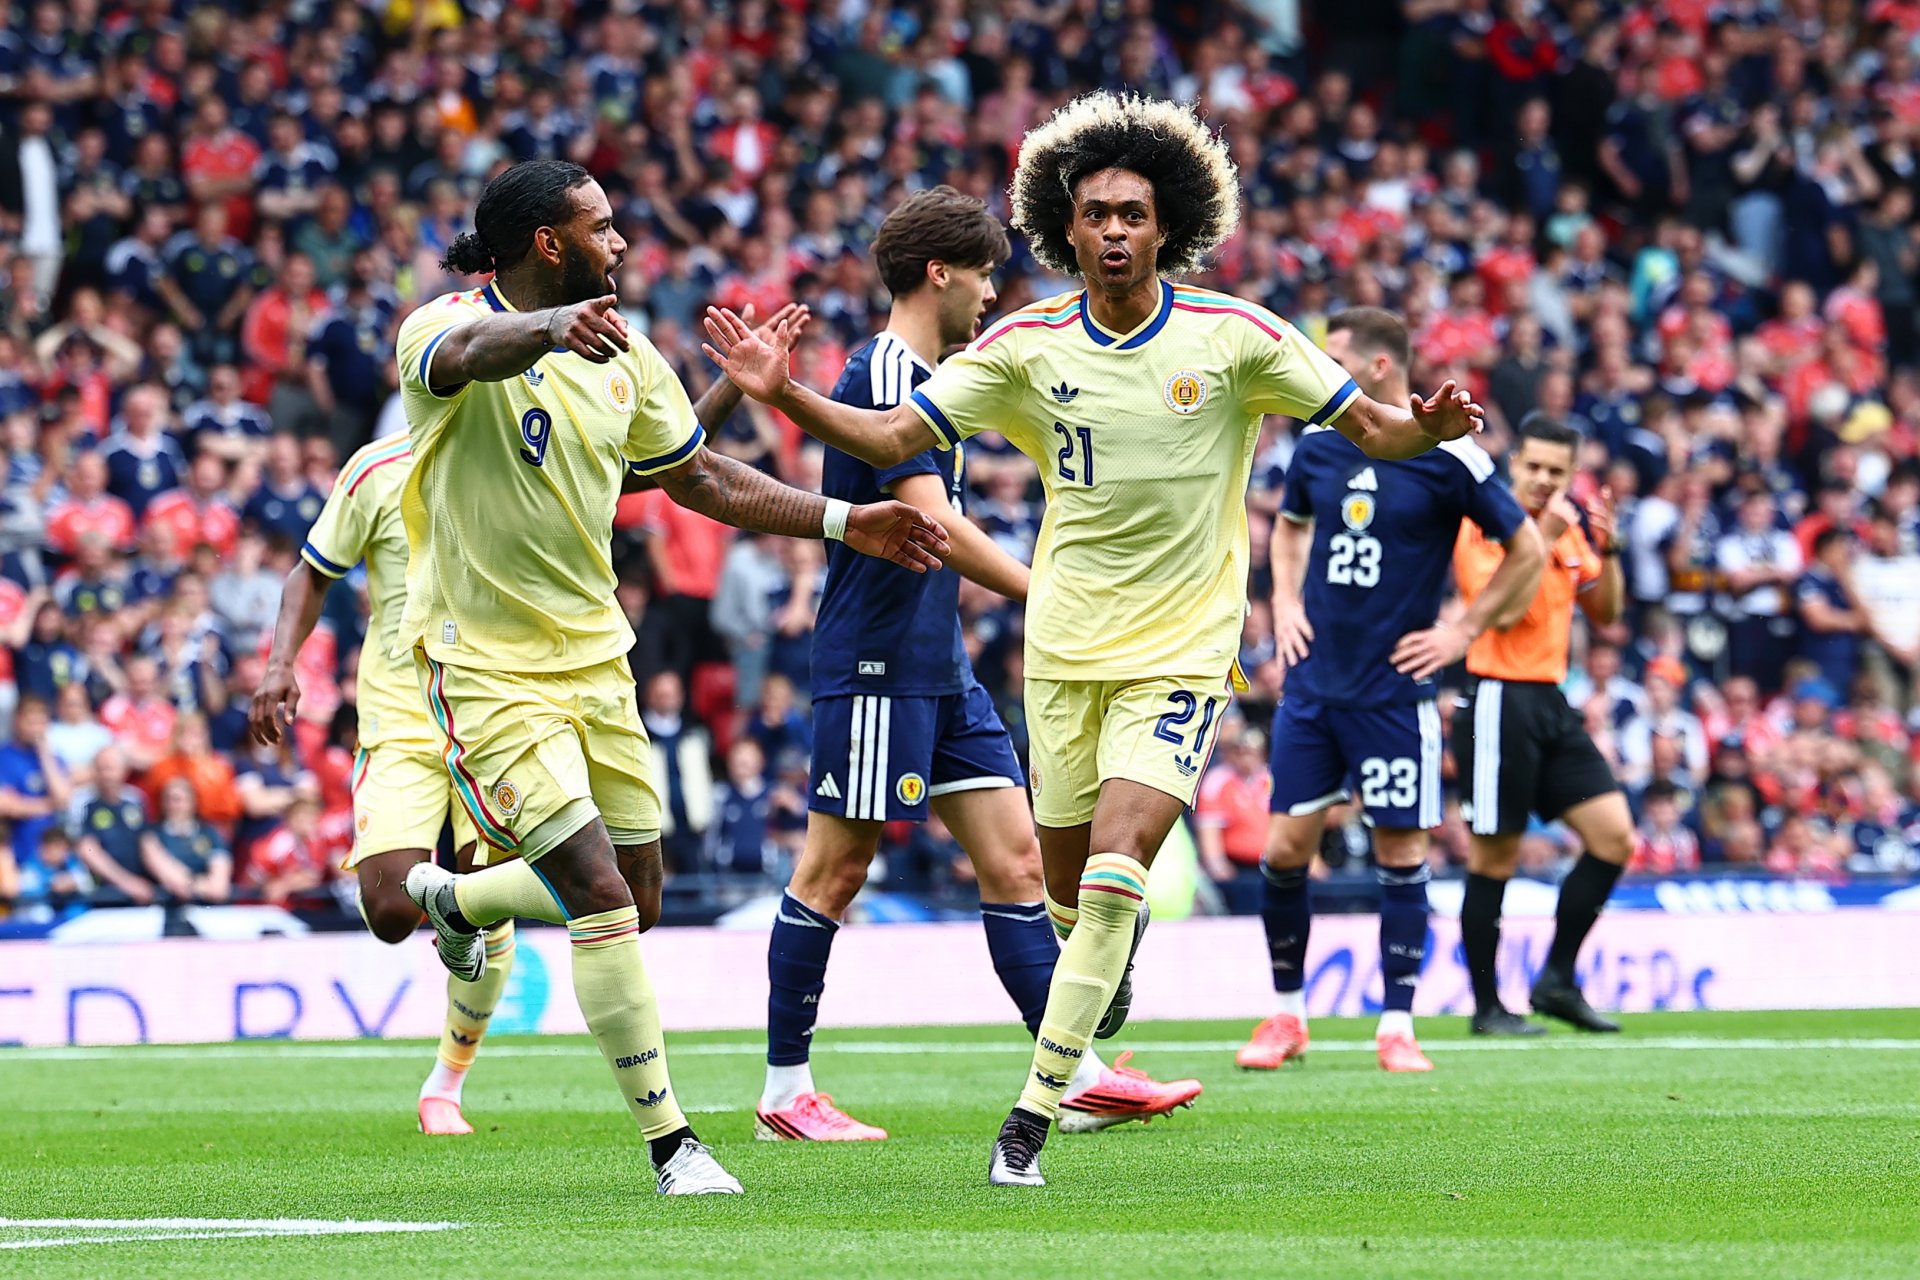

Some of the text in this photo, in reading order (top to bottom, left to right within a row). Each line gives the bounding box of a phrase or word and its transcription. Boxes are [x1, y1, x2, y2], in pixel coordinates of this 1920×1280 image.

[520, 407, 551, 467] 9
[1054, 421, 1094, 486] 21
[1327, 533, 1383, 588] 23
[1153, 689, 1217, 754] 21
[1361, 757, 1418, 808] 23
